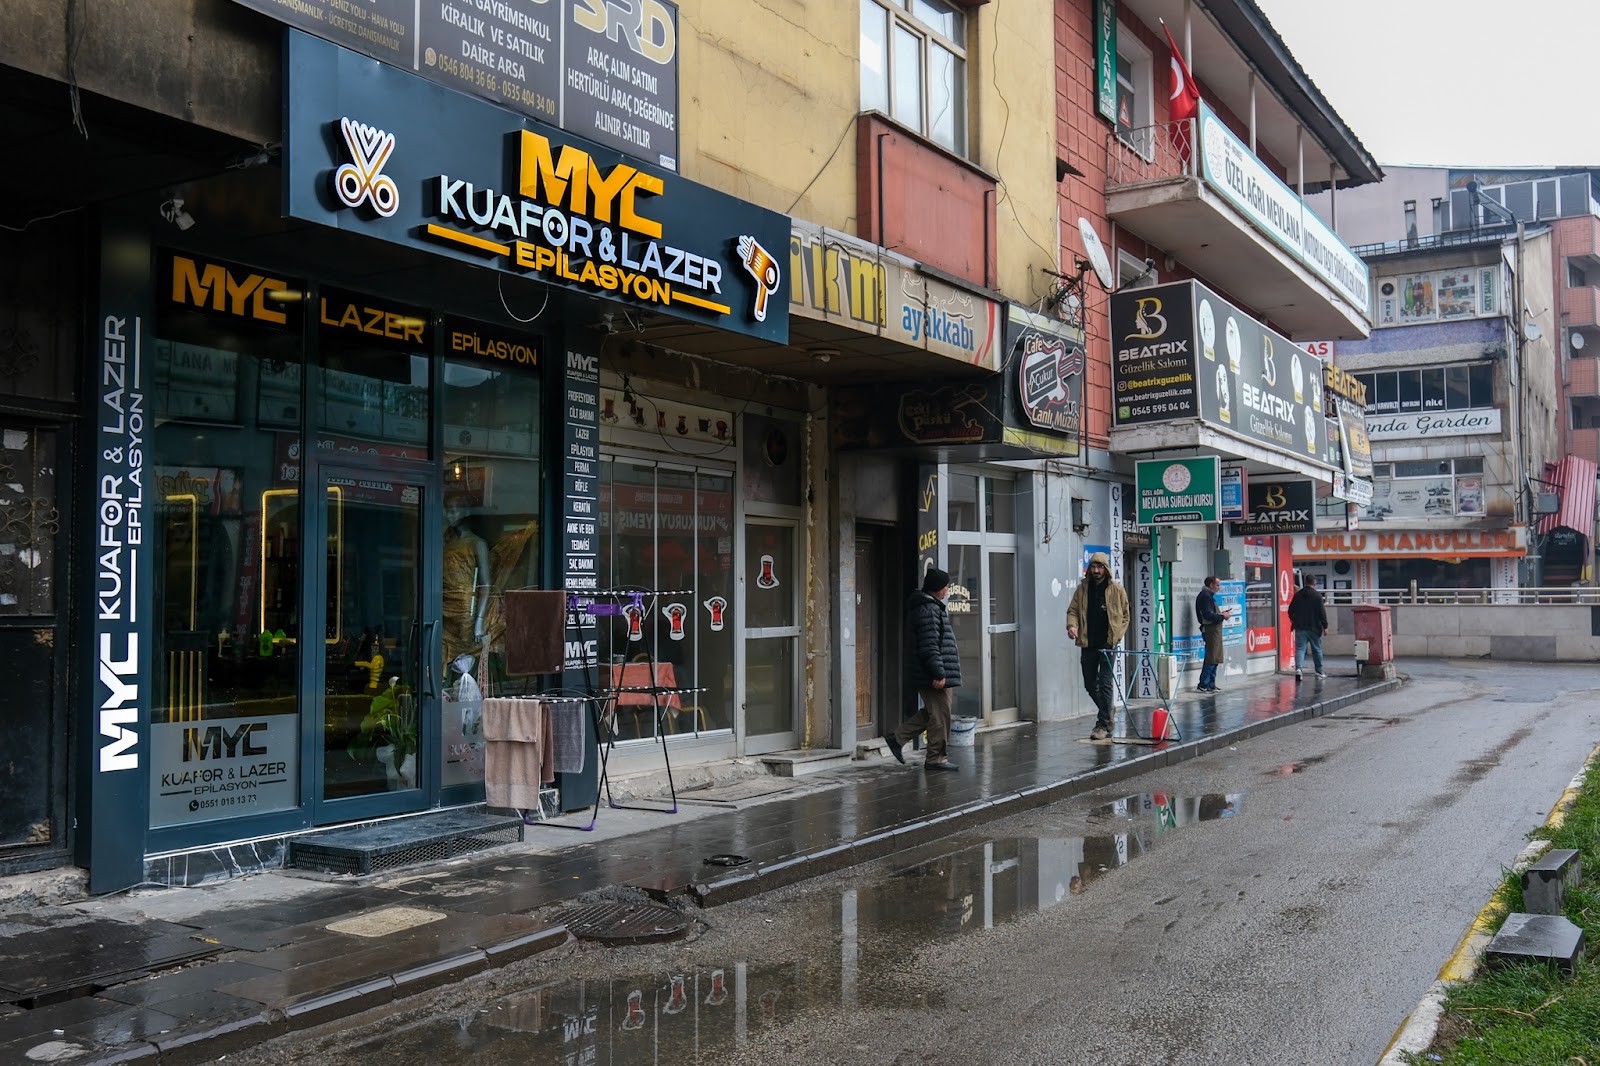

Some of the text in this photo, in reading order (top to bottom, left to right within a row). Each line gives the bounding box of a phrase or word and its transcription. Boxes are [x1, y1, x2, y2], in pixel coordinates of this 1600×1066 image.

[328, 10, 357, 34] ÜCRETSİZ
[358, 26, 400, 52] DANIŞMANLIK
[350, 4, 366, 20] YOLU
[371, 10, 388, 29] HAVA
[389, 19, 405, 36] YOLU
[441, 3, 545, 64] KİRALIK VE SATILIK
[574, 0, 675, 65] SRD
[1102, 2, 1110, 93] MEVLANA
[462, 40, 526, 82] DAİRE ARSA
[587, 46, 658, 95] ARAÇ ALIM SATIMI
[439, 54, 555, 116] 0546 804 36 66 0535 404 34 00
[568, 68, 674, 131] HERTÜRLÜ ARAÇ DEĞERİNDE
[595, 111, 650, 149] ALINIR SATILIR
[520, 128, 664, 240] MYC
[1225, 149, 1246, 199] ÖZEL
[1247, 177, 1265, 216] AĞRI
[1267, 193, 1301, 246] MEVLANA
[599, 227, 617, 262] &
[622, 232, 722, 294] LAZER
[516, 239, 670, 305] EPİLASYON
[173, 255, 287, 324] MYC
[320, 297, 425, 344] LAZER
[903, 305, 974, 352] ayakkabı
[452, 331, 537, 366] EPİLASYON
[1026, 338, 1042, 354] Cafe
[1119, 340, 1188, 362] BEATRIX
[567, 351, 598, 373] MYC
[1120, 358, 1187, 375] Güzellik Salonu
[102, 315, 126, 434] LAZER
[1035, 369, 1053, 389] Çukur
[1128, 373, 1192, 390] @beatrixguzellik
[1326, 363, 1367, 408] BEATRIX
[1119, 388, 1192, 403] www.beatrixguzellik.com
[1243, 382, 1295, 425] BEATRIX
[1032, 406, 1053, 424] Canlı
[1132, 401, 1190, 416] 0545 595 04 04
[575, 428, 589, 440] LAZER
[1250, 414, 1275, 439] Güzellik
[1417, 413, 1492, 434] Garden
[103, 446, 123, 464] &
[571, 442, 594, 457] EPİLASYON
[125, 392, 143, 545] EPİLASYON
[575, 462, 589, 473] PERMA
[573, 501, 590, 513] KERATİN
[1142, 494, 1213, 509] MEVLANA SÜRÜCÜ KURSU
[1239, 522, 1306, 532] Güzellik Salonu
[1248, 510, 1309, 523] EATRIX
[567, 523, 594, 534] AKNE VE BEN
[571, 538, 589, 550] TEDAVİSİ
[919, 530, 937, 552] CAFE
[1307, 533, 1366, 551] UNLU
[569, 559, 578, 571] SAÇ
[1139, 552, 1151, 623] ÇALIŞKAN
[1255, 633, 1270, 644] vodafone
[99, 632, 138, 772] MYC
[183, 722, 268, 762] MYC
[227, 768, 235, 779] &
[240, 762, 286, 778] LAZER
[194, 780, 257, 795] EPİLASYON
[200, 794, 257, 809] 0551 018 13 73
